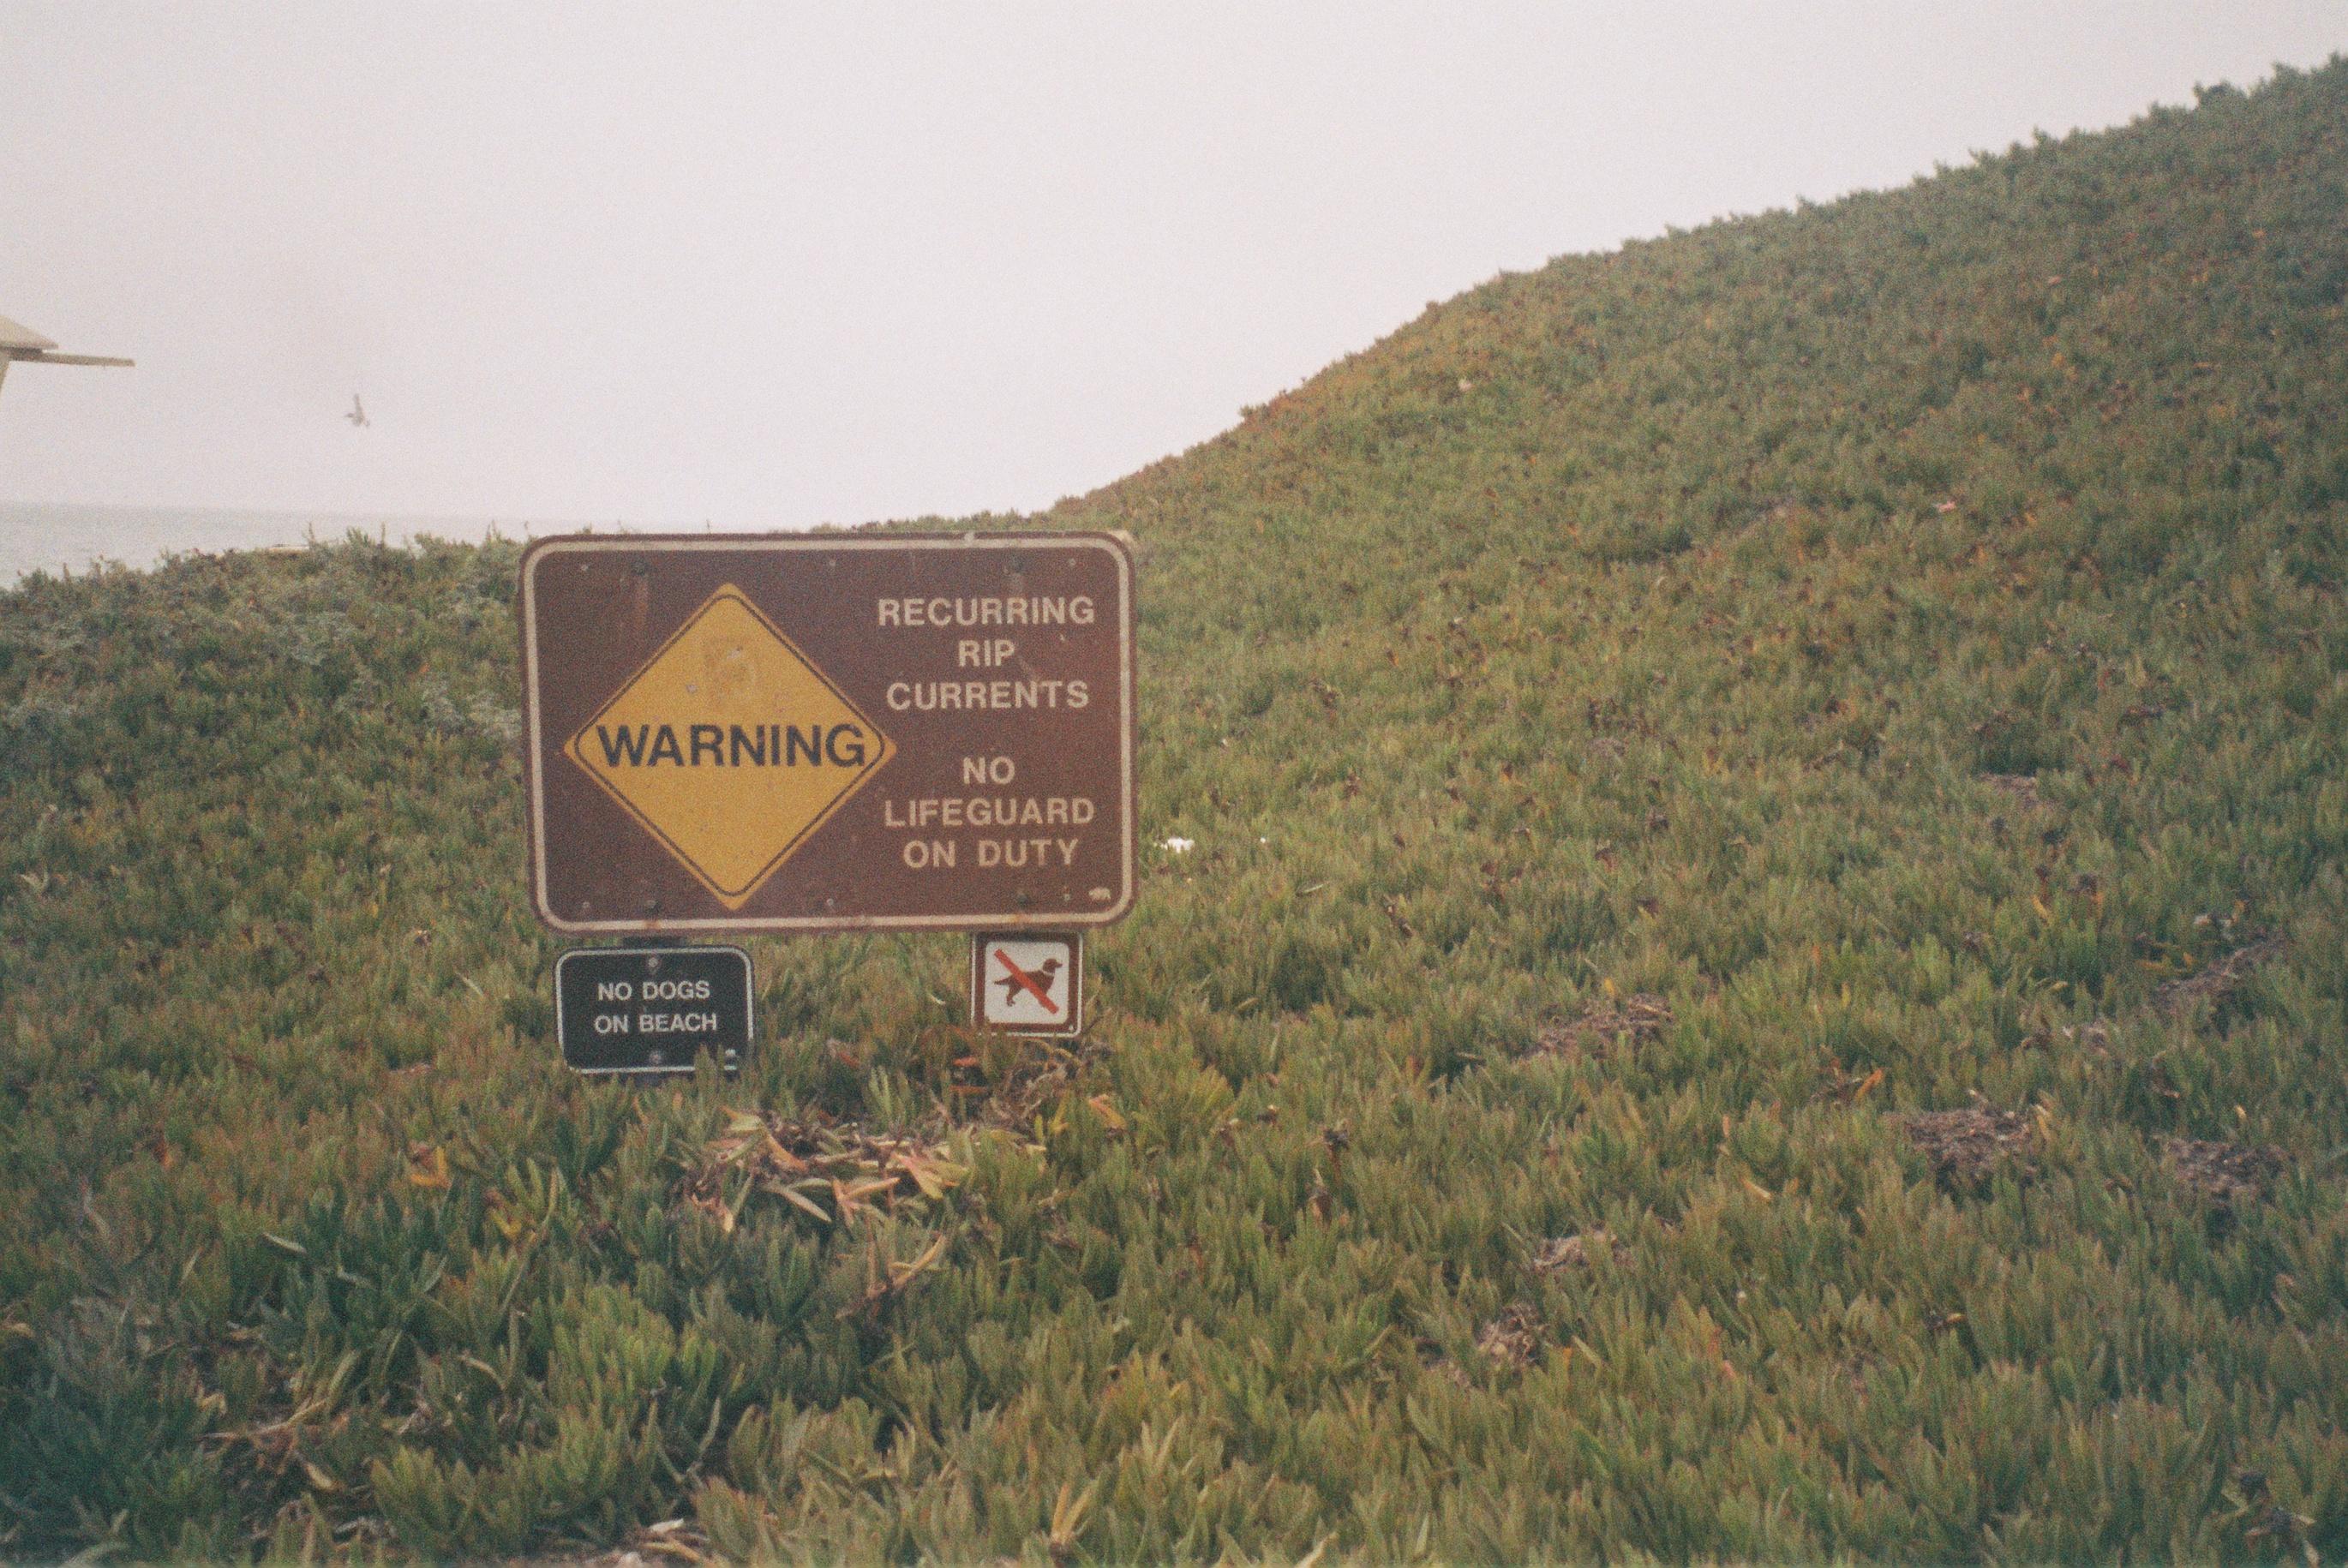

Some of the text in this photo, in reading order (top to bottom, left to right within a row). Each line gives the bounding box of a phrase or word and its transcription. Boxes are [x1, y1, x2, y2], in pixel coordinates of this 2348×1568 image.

[878, 595, 1094, 625] RECURRING
[958, 640, 1015, 667] RIP
[886, 680, 1089, 710] CURRENTS
[596, 723, 866, 768] WARNING
[962, 756, 1015, 785] NO
[884, 798, 1094, 827] LIFEGUARD
[903, 838, 1079, 868] ON DUTY
[598, 980, 710, 1001] NO DOGS
[595, 1013, 717, 1033] ON BEACH
